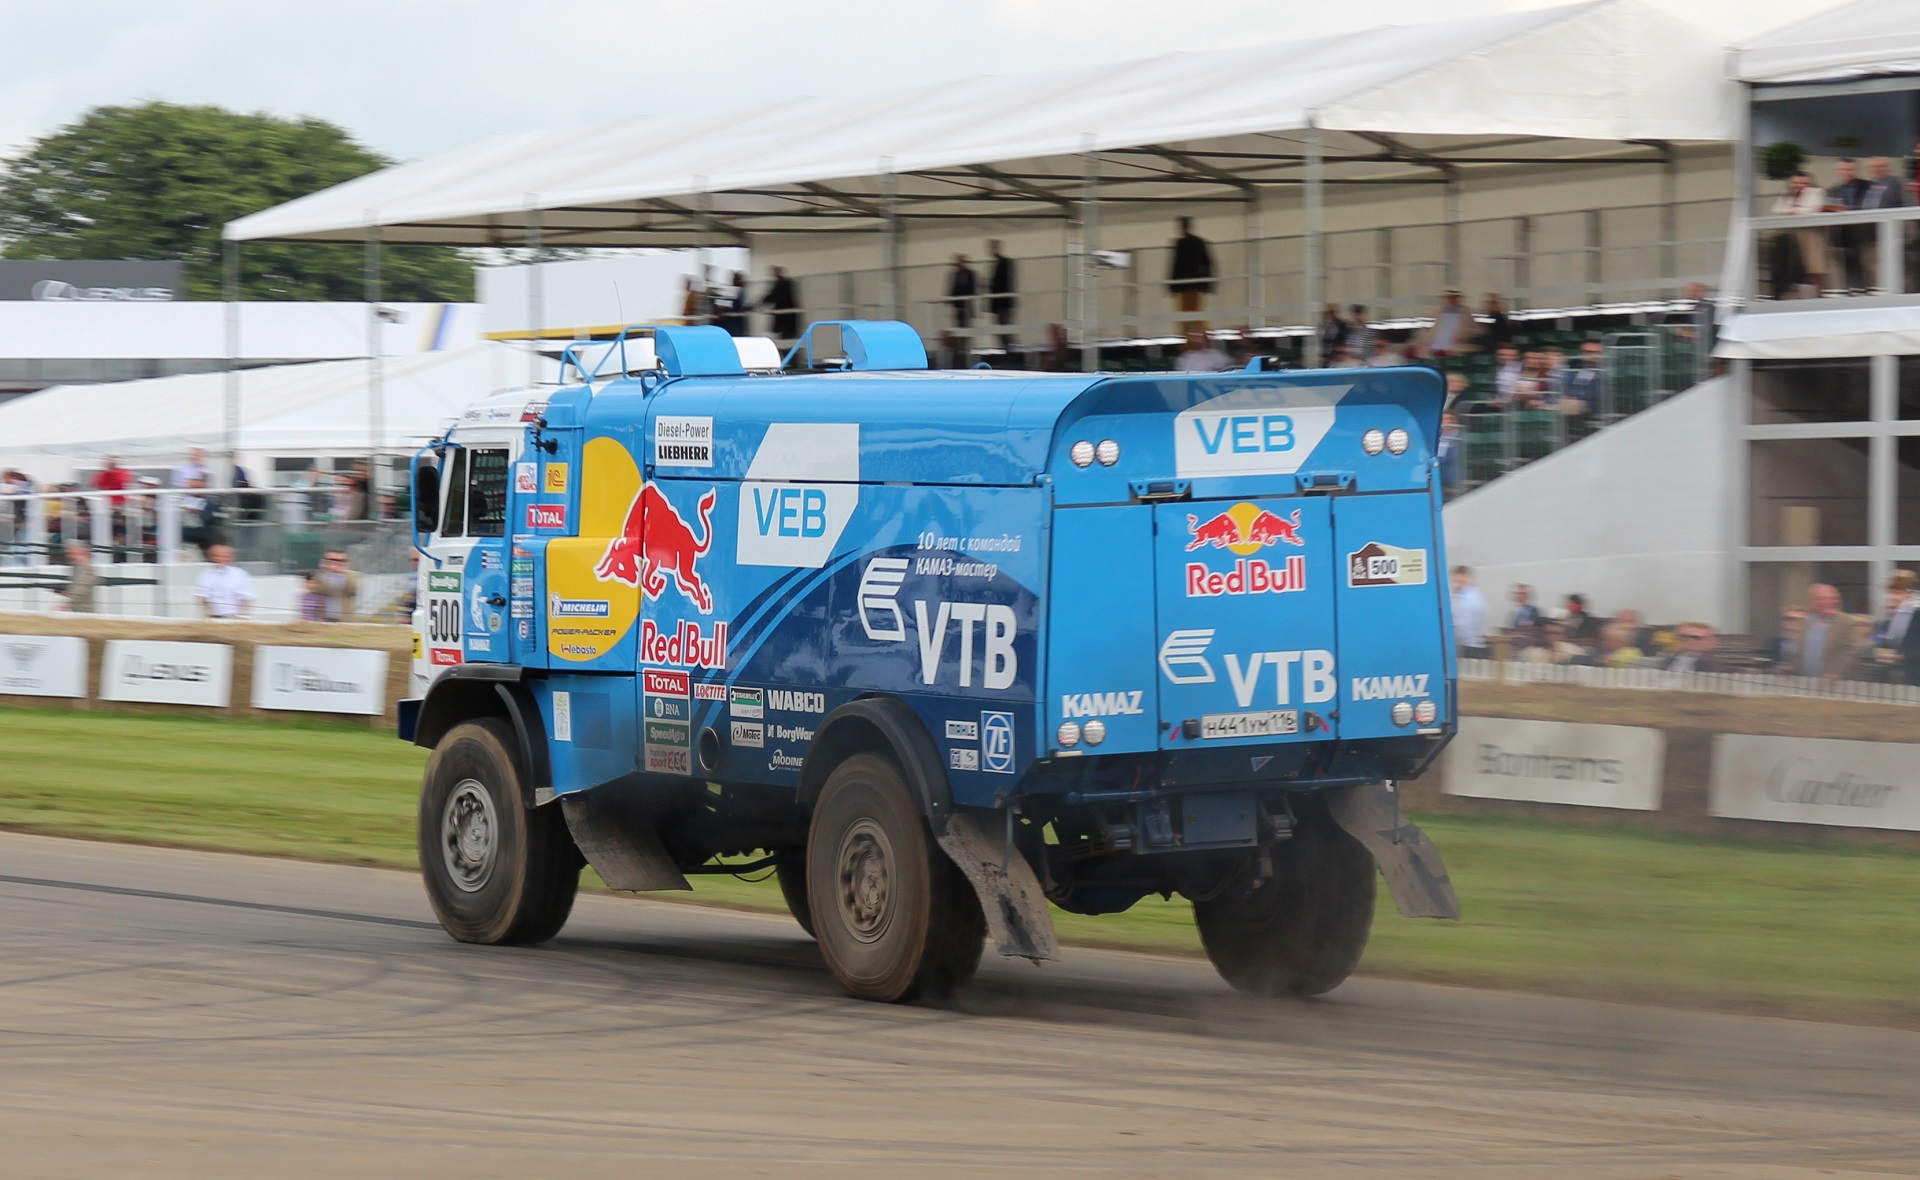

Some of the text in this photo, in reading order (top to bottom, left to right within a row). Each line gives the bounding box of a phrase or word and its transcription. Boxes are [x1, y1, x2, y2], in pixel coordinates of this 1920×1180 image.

[658, 422, 710, 438] Diesel-Power
[1193, 414, 1296, 455] VEB
[658, 445, 709, 461] LIEBHERR
[528, 508, 563, 525] TOTAL
[753, 488, 827, 538] VEB
[917, 531, 1022, 552] 10 лет с командой
[915, 557, 998, 582] КАМАЗ-мастер
[1186, 557, 1305, 596] Red Bull
[1371, 559, 1397, 575] 500
[562, 603, 607, 613] MICHELIN
[430, 599, 460, 641] 500
[552, 628, 617, 636] POWER-PACKER
[561, 643, 597, 655] Webasto
[641, 620, 727, 667] Red Bull
[915, 600, 1018, 690] VTB
[648, 674, 685, 692] TOTAL
[1223, 649, 1338, 708] VTB
[1352, 673, 1431, 701] KAMAZ
[695, 685, 726, 699] LOCTITE
[767, 689, 825, 714] WABCO
[665, 703, 680, 716] BNA
[1062, 690, 1145, 719] KAMAZ
[650, 726, 686, 743] SpeedAgro
[772, 756, 804, 767] MODINE
